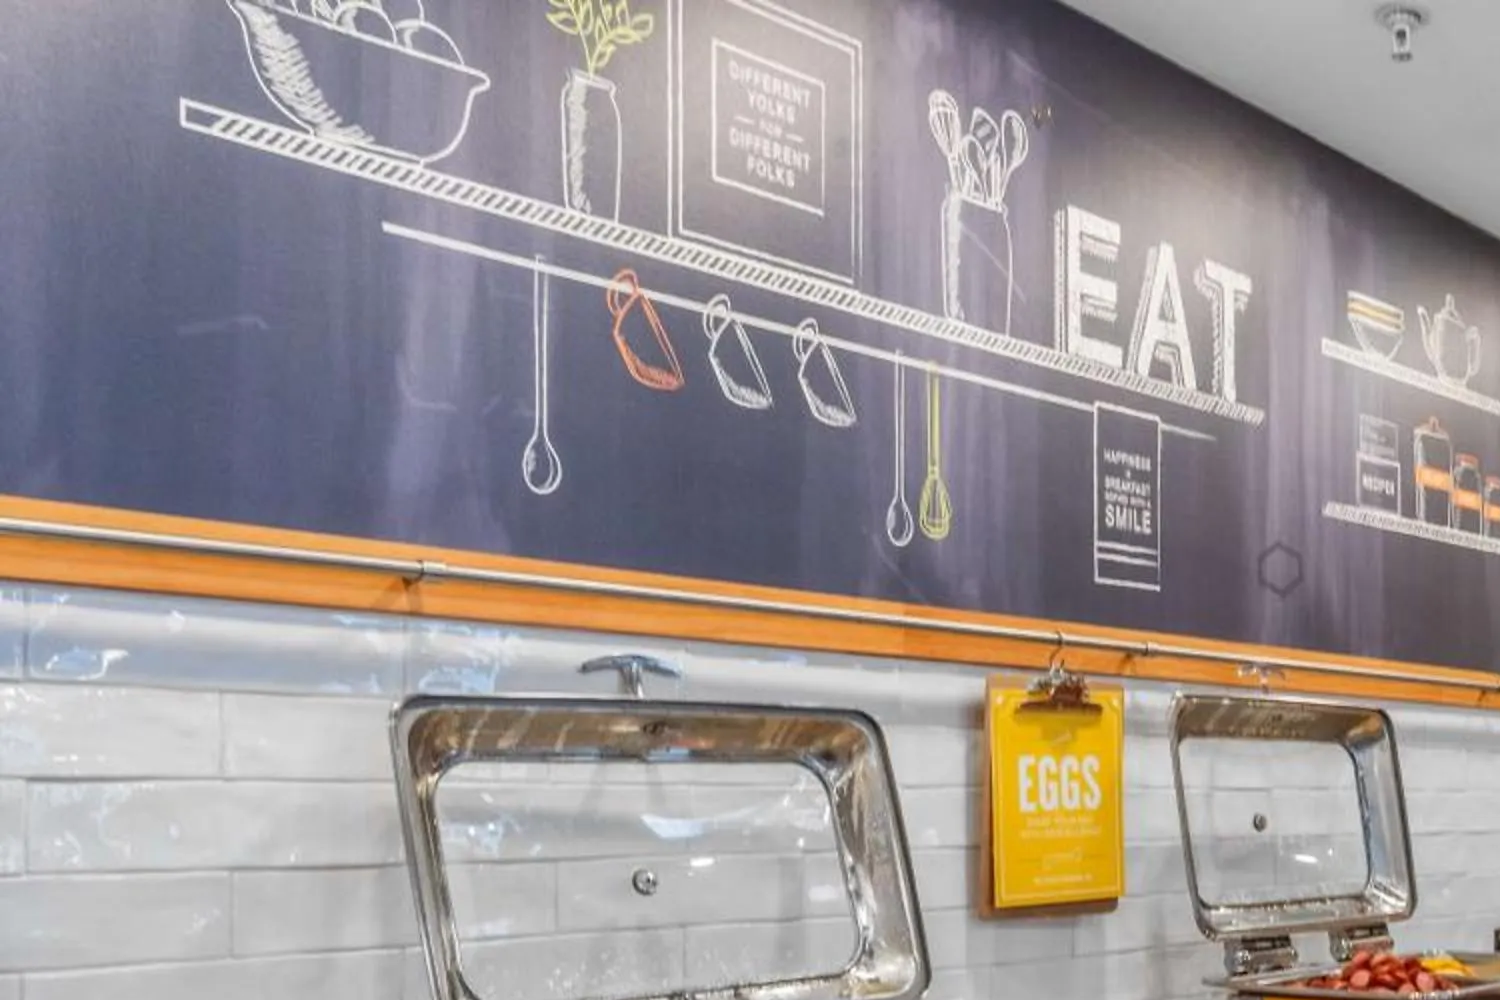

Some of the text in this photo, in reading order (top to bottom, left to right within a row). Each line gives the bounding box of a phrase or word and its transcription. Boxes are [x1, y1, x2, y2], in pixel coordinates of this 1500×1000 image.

[1054, 203, 1254, 404] EAT
[1104, 503, 1152, 535] SMILE
[1018, 753, 1102, 814] EGGS
